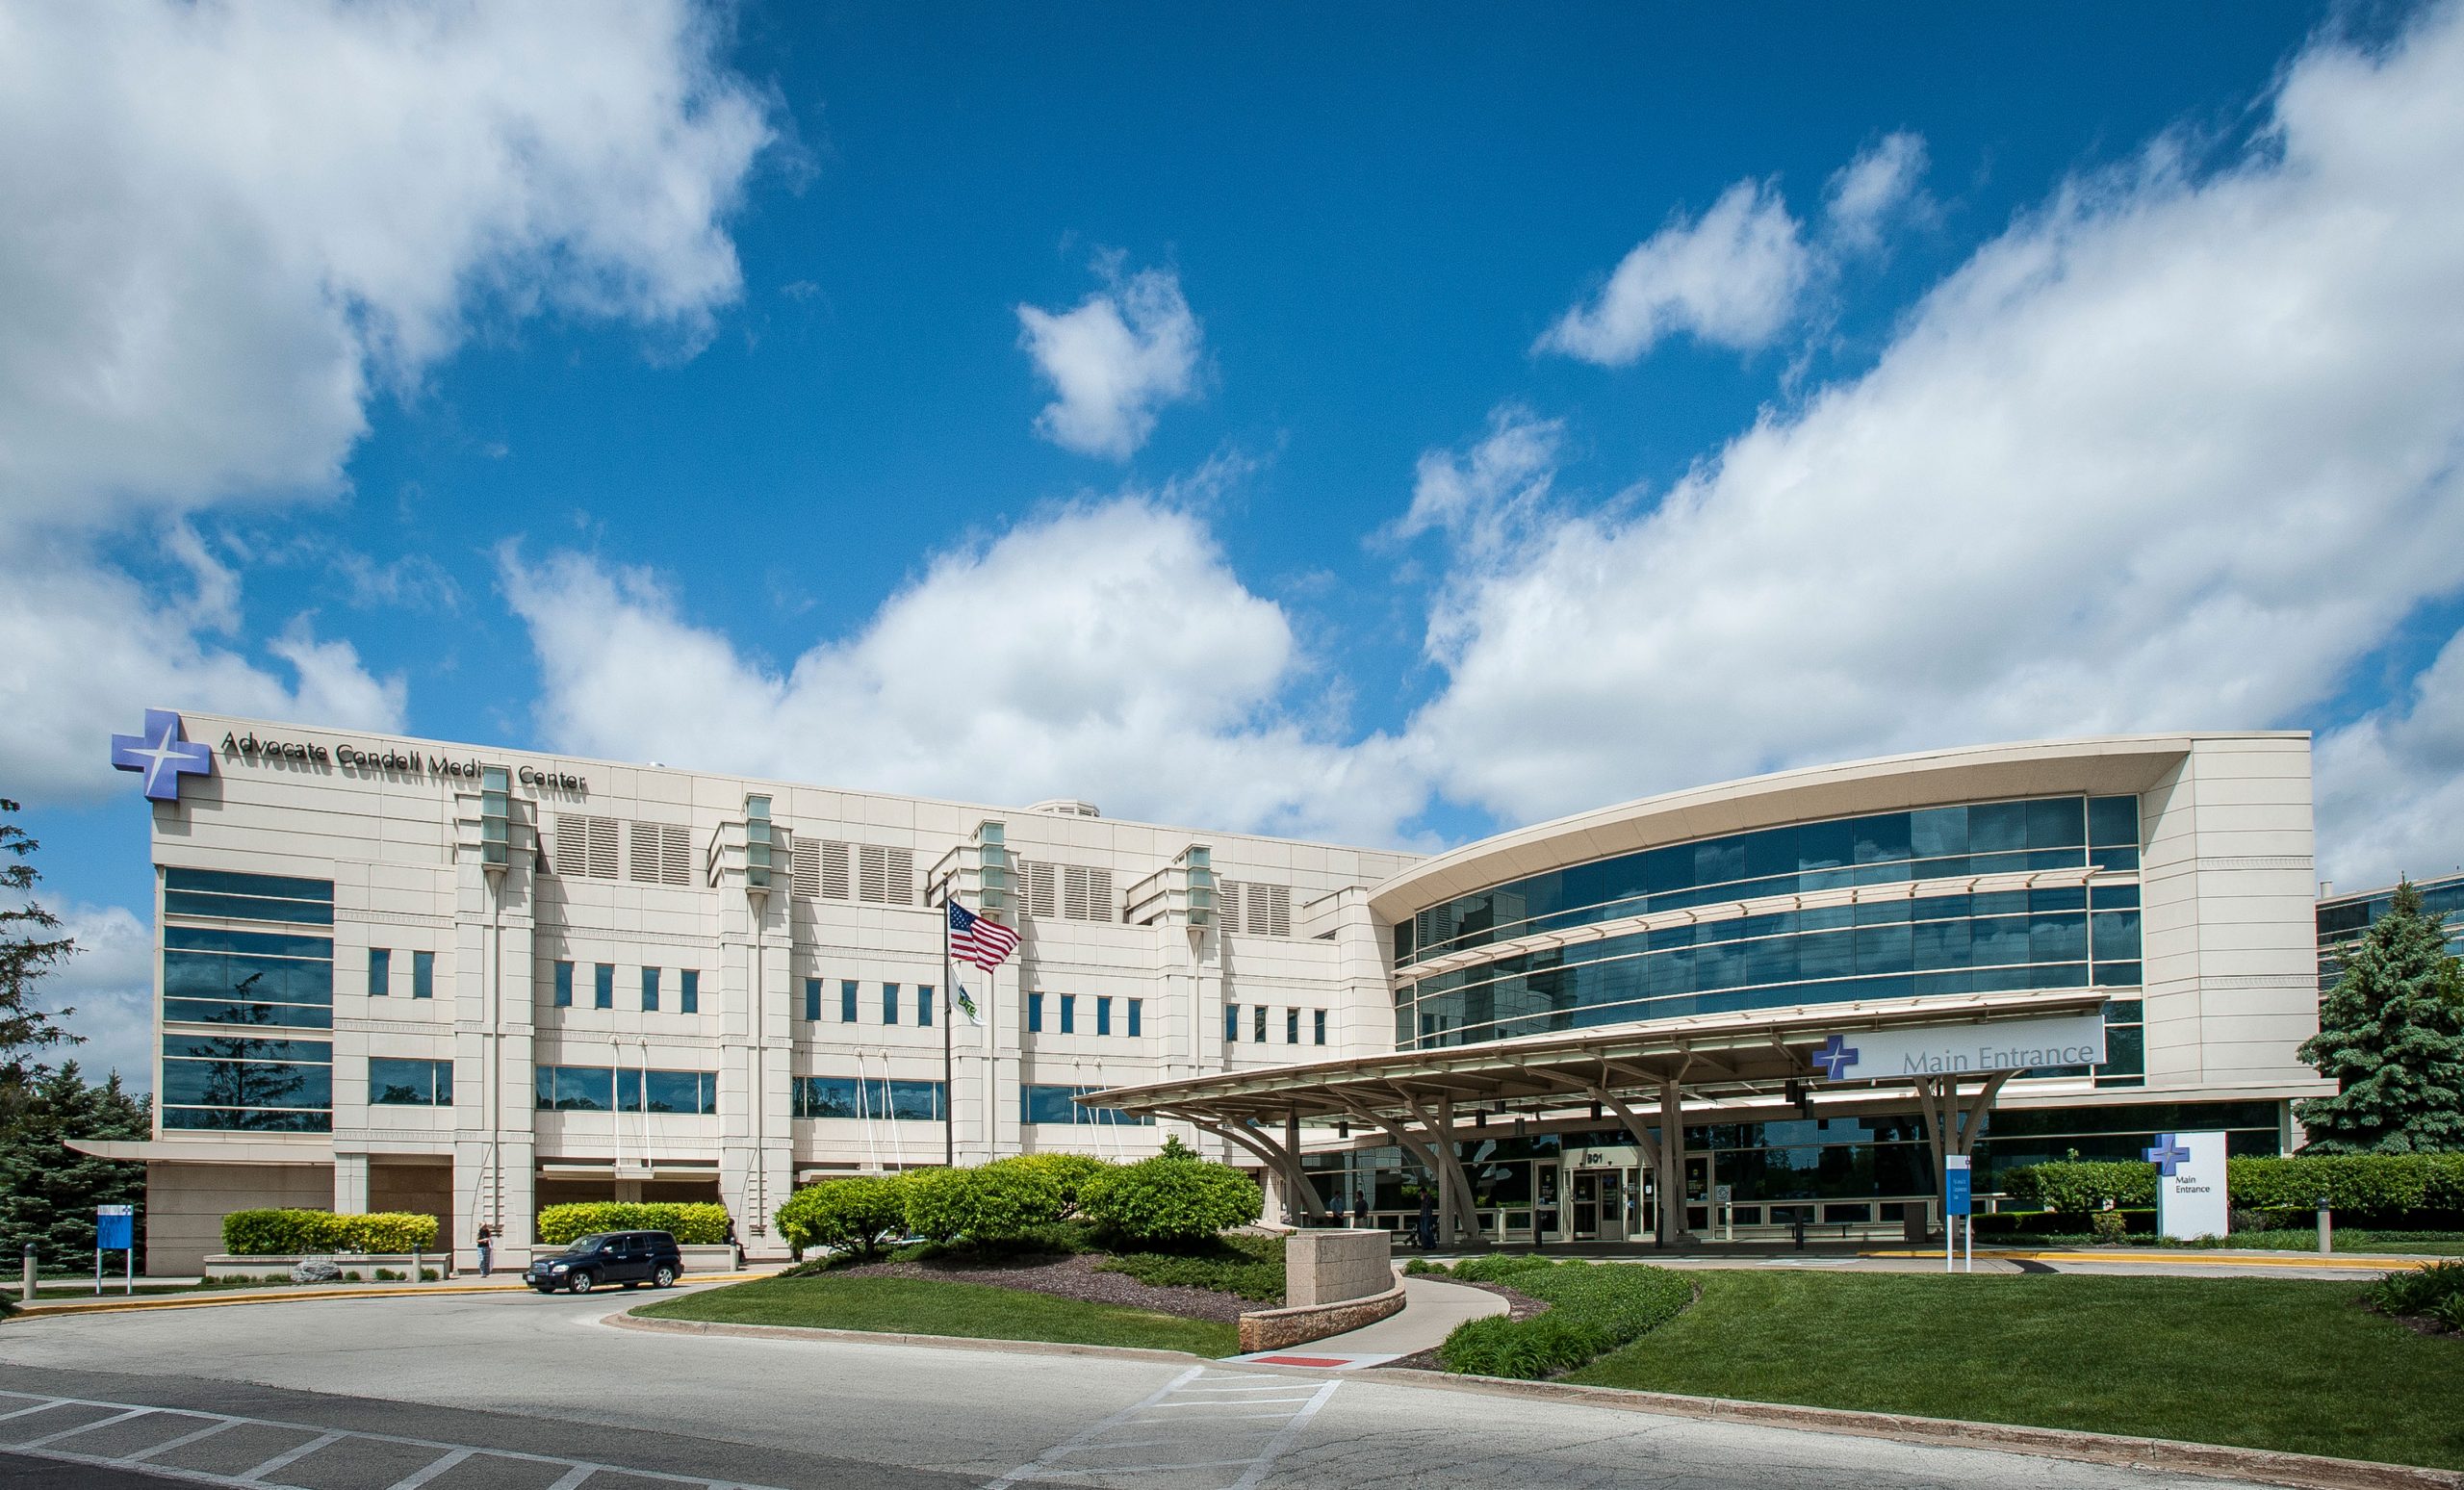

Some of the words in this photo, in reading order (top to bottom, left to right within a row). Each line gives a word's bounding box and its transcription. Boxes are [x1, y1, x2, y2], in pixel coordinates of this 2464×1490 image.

[220, 731, 327, 760] Advocate
[336, 744, 420, 772] Condell
[427, 755, 483, 779] Medi
[518, 765, 586, 790] Center
[1903, 1049, 1967, 1074] Main
[1979, 1045, 2093, 1069] Entrance
[2175, 1175, 2196, 1184] Main
[2175, 1185, 2211, 1194] Entrance
